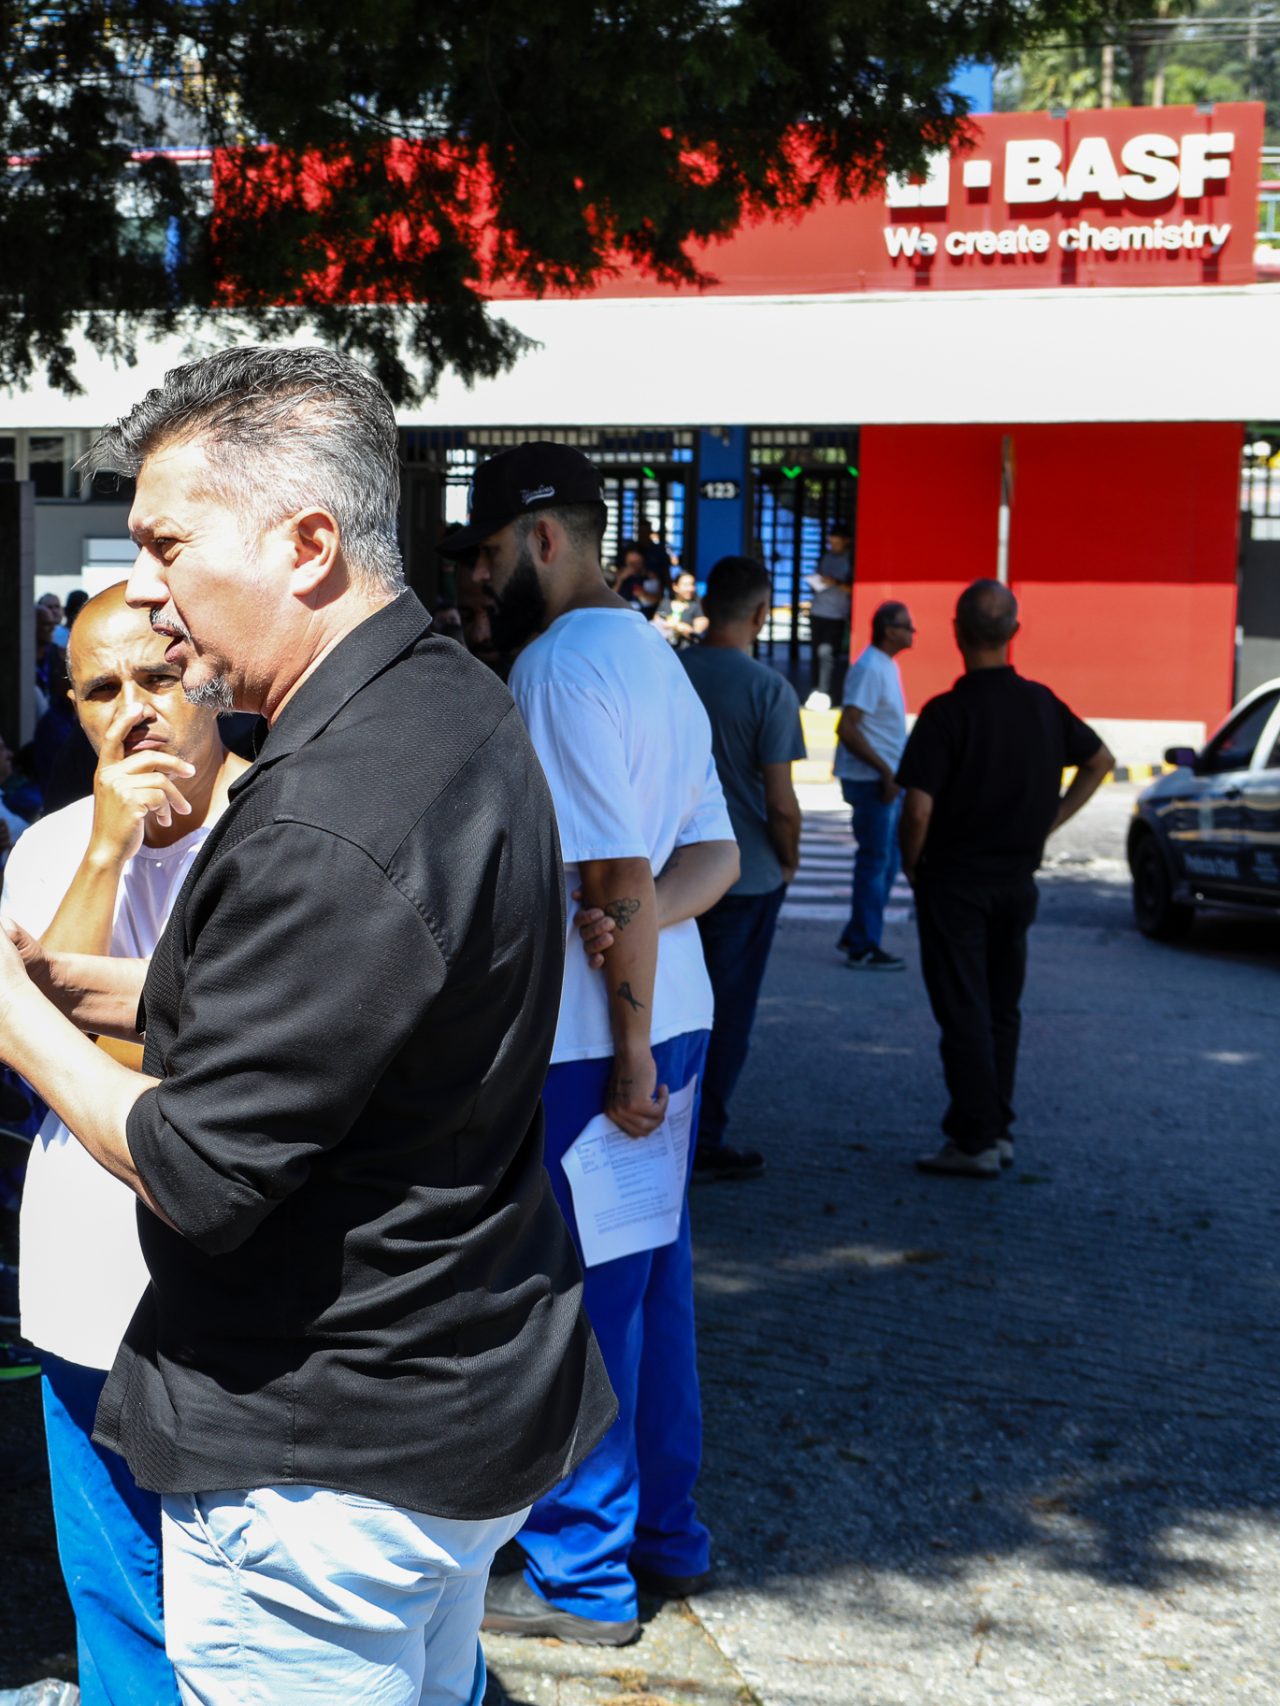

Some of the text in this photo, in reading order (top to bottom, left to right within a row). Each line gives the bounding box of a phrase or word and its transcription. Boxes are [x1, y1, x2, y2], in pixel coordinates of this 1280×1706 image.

[1005, 133, 1234, 202] BASF
[884, 219, 1231, 257] We create chemistry
[705, 483, 735, 498] 123
